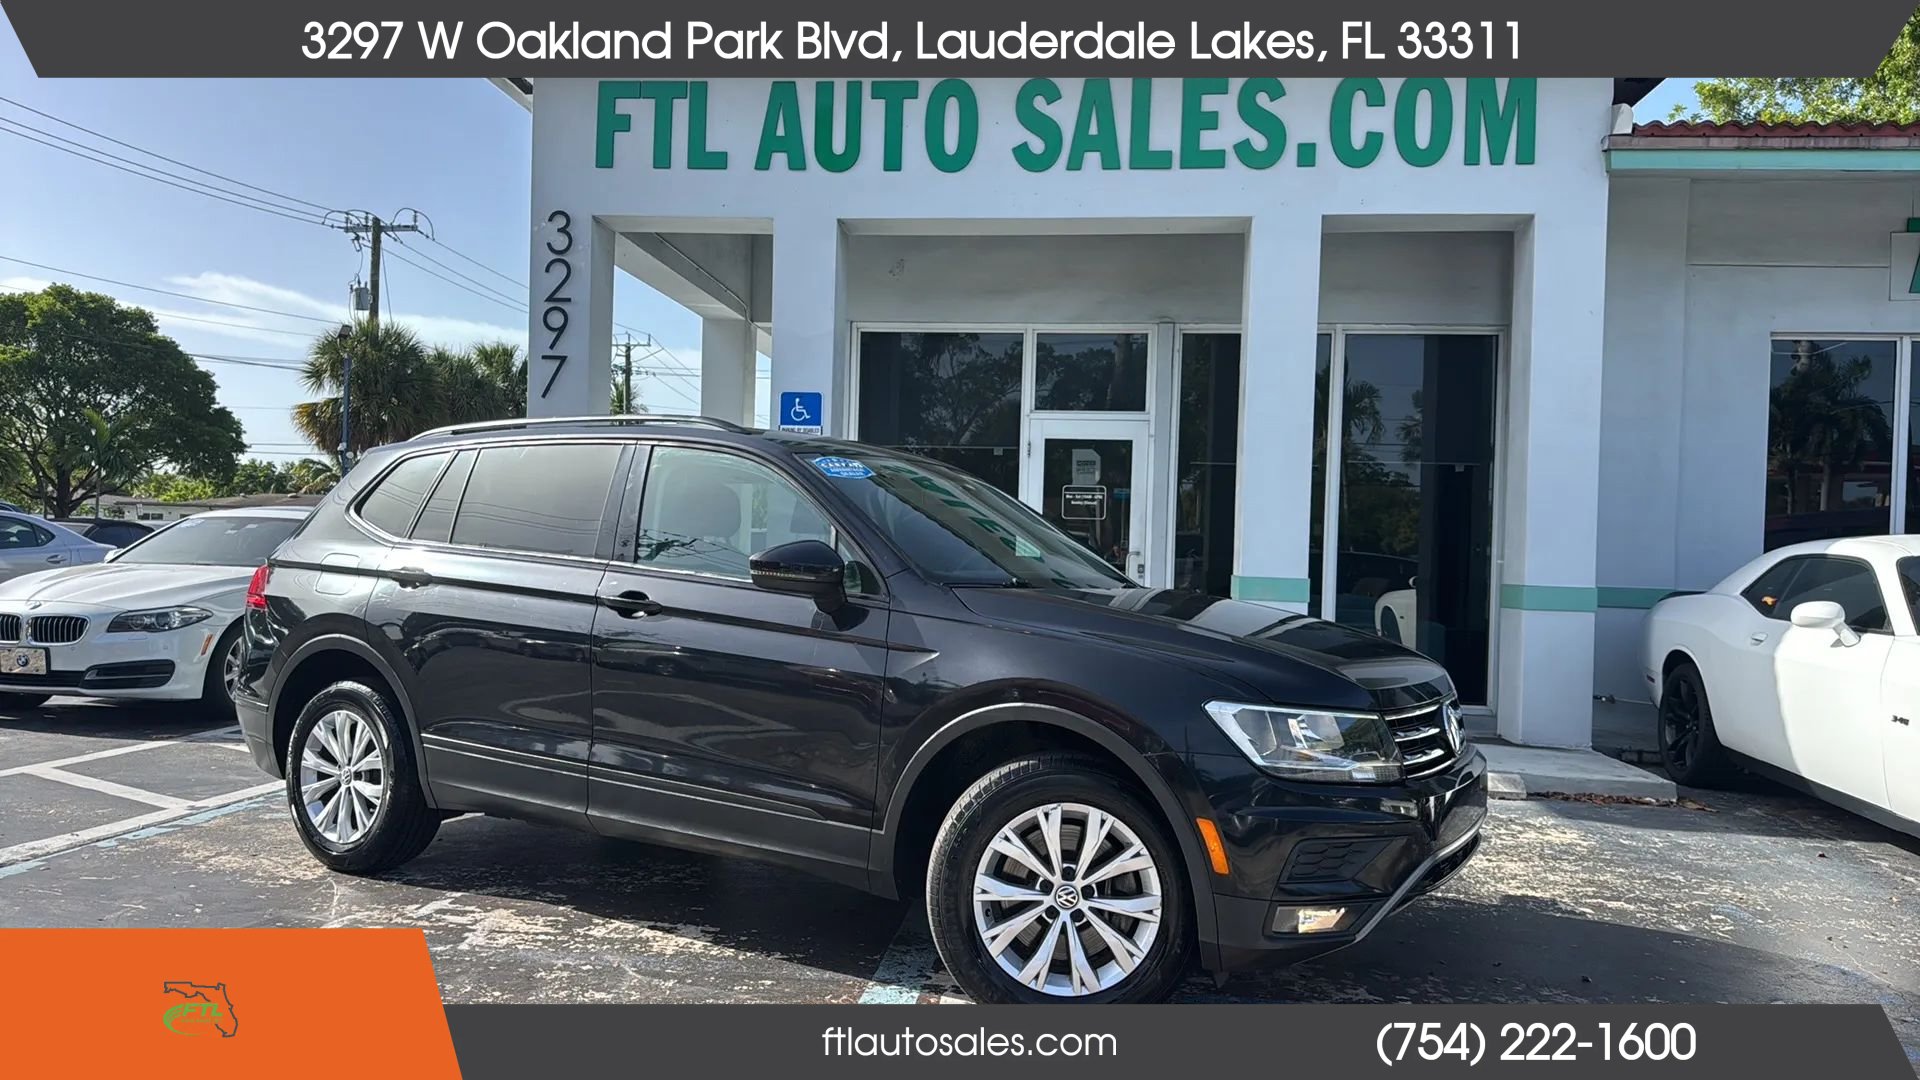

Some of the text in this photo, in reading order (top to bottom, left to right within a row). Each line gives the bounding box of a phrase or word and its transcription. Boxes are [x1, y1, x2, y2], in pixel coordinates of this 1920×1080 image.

[595, 78, 1538, 174] FTL AUTO SALES.COM
[541, 210, 573, 399] 3297
